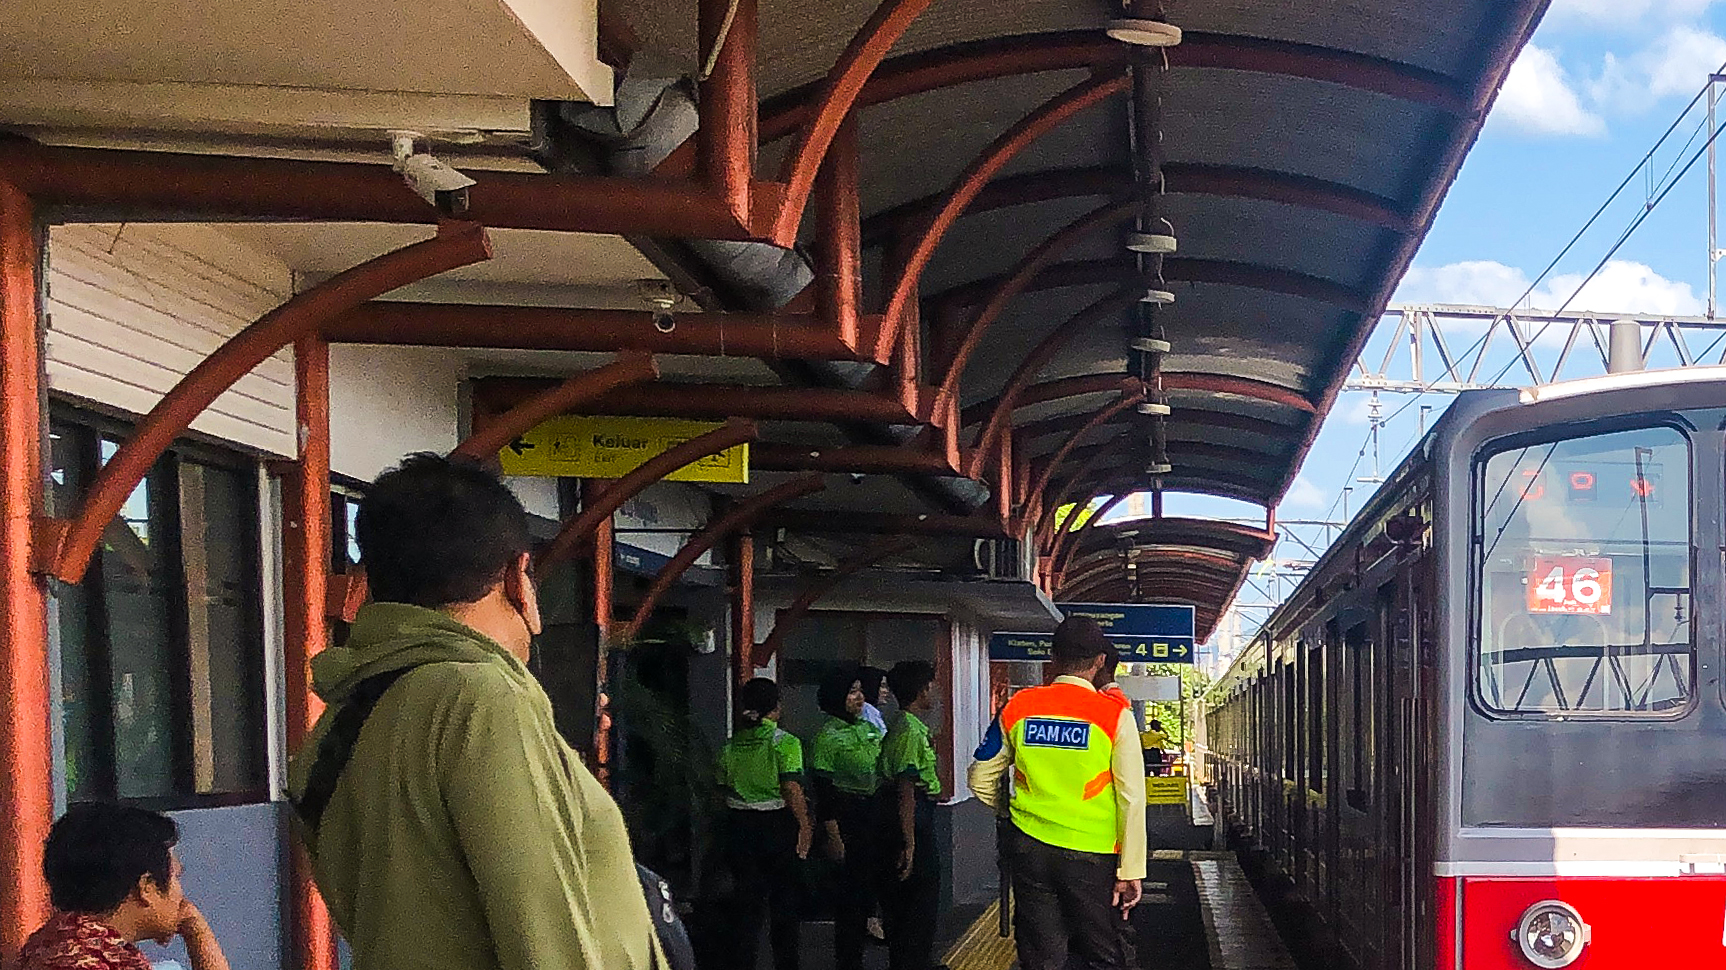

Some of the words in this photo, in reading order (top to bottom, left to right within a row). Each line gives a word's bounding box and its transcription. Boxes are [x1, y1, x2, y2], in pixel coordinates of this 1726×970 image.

[592, 434, 649, 449] Keluar
[1536, 566, 1602, 605] 46
[1135, 643, 1148, 656] 4
[1027, 724, 1060, 742] PAM
[1061, 726, 1087, 744] KCI
